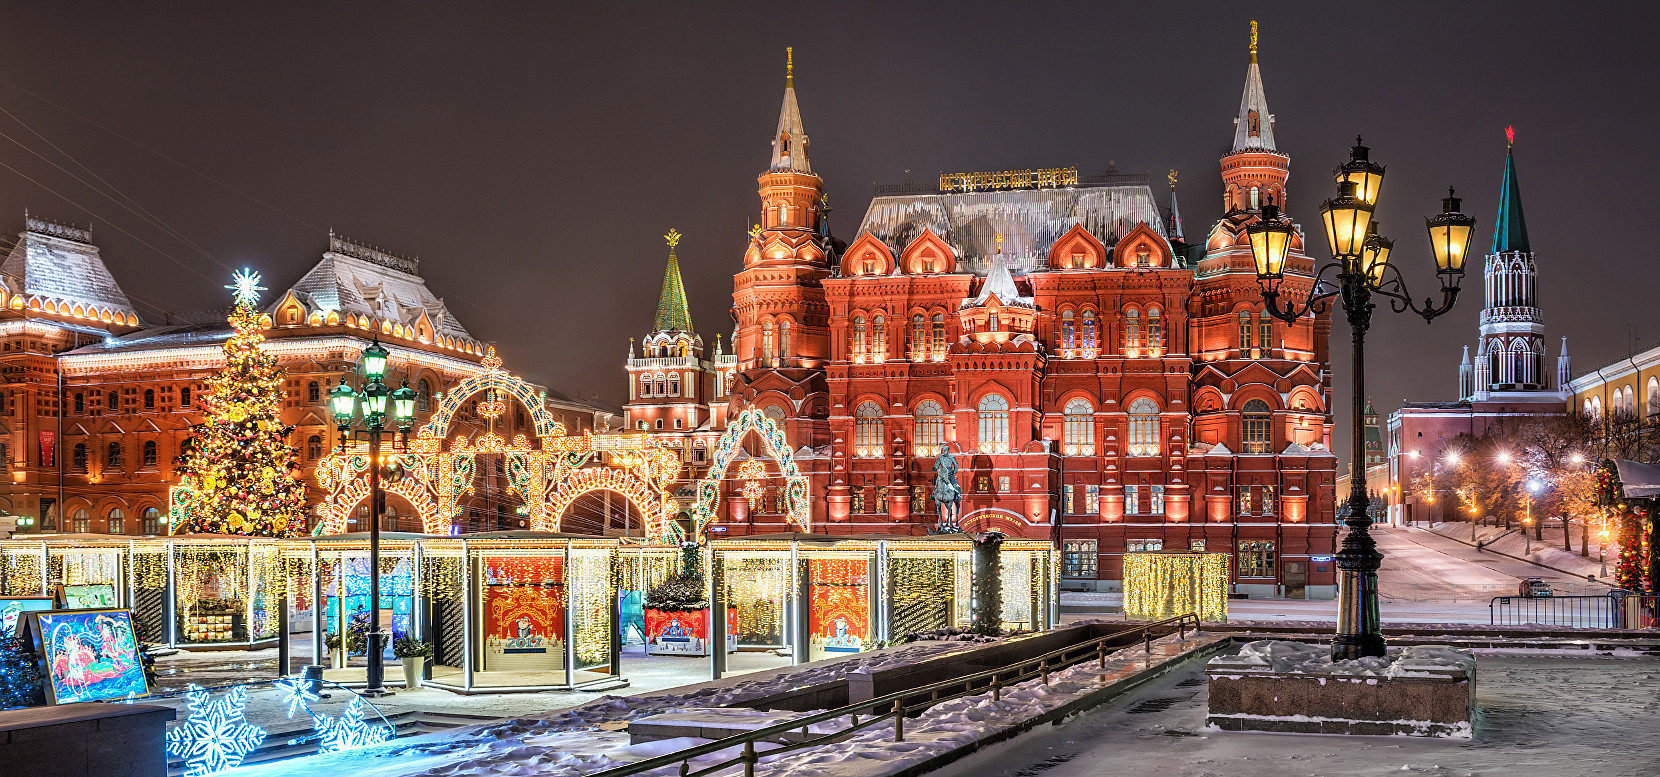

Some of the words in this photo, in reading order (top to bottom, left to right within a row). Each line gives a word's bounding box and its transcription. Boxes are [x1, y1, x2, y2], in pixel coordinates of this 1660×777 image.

[940, 168, 1032, 191] ИСТОРИЧЕСКИЙ
[1037, 165, 1078, 187] МУЗЕЙ
[661, 626, 693, 638] 2017
[508, 637, 542, 648] 2017
[827, 636, 856, 647] 2017
